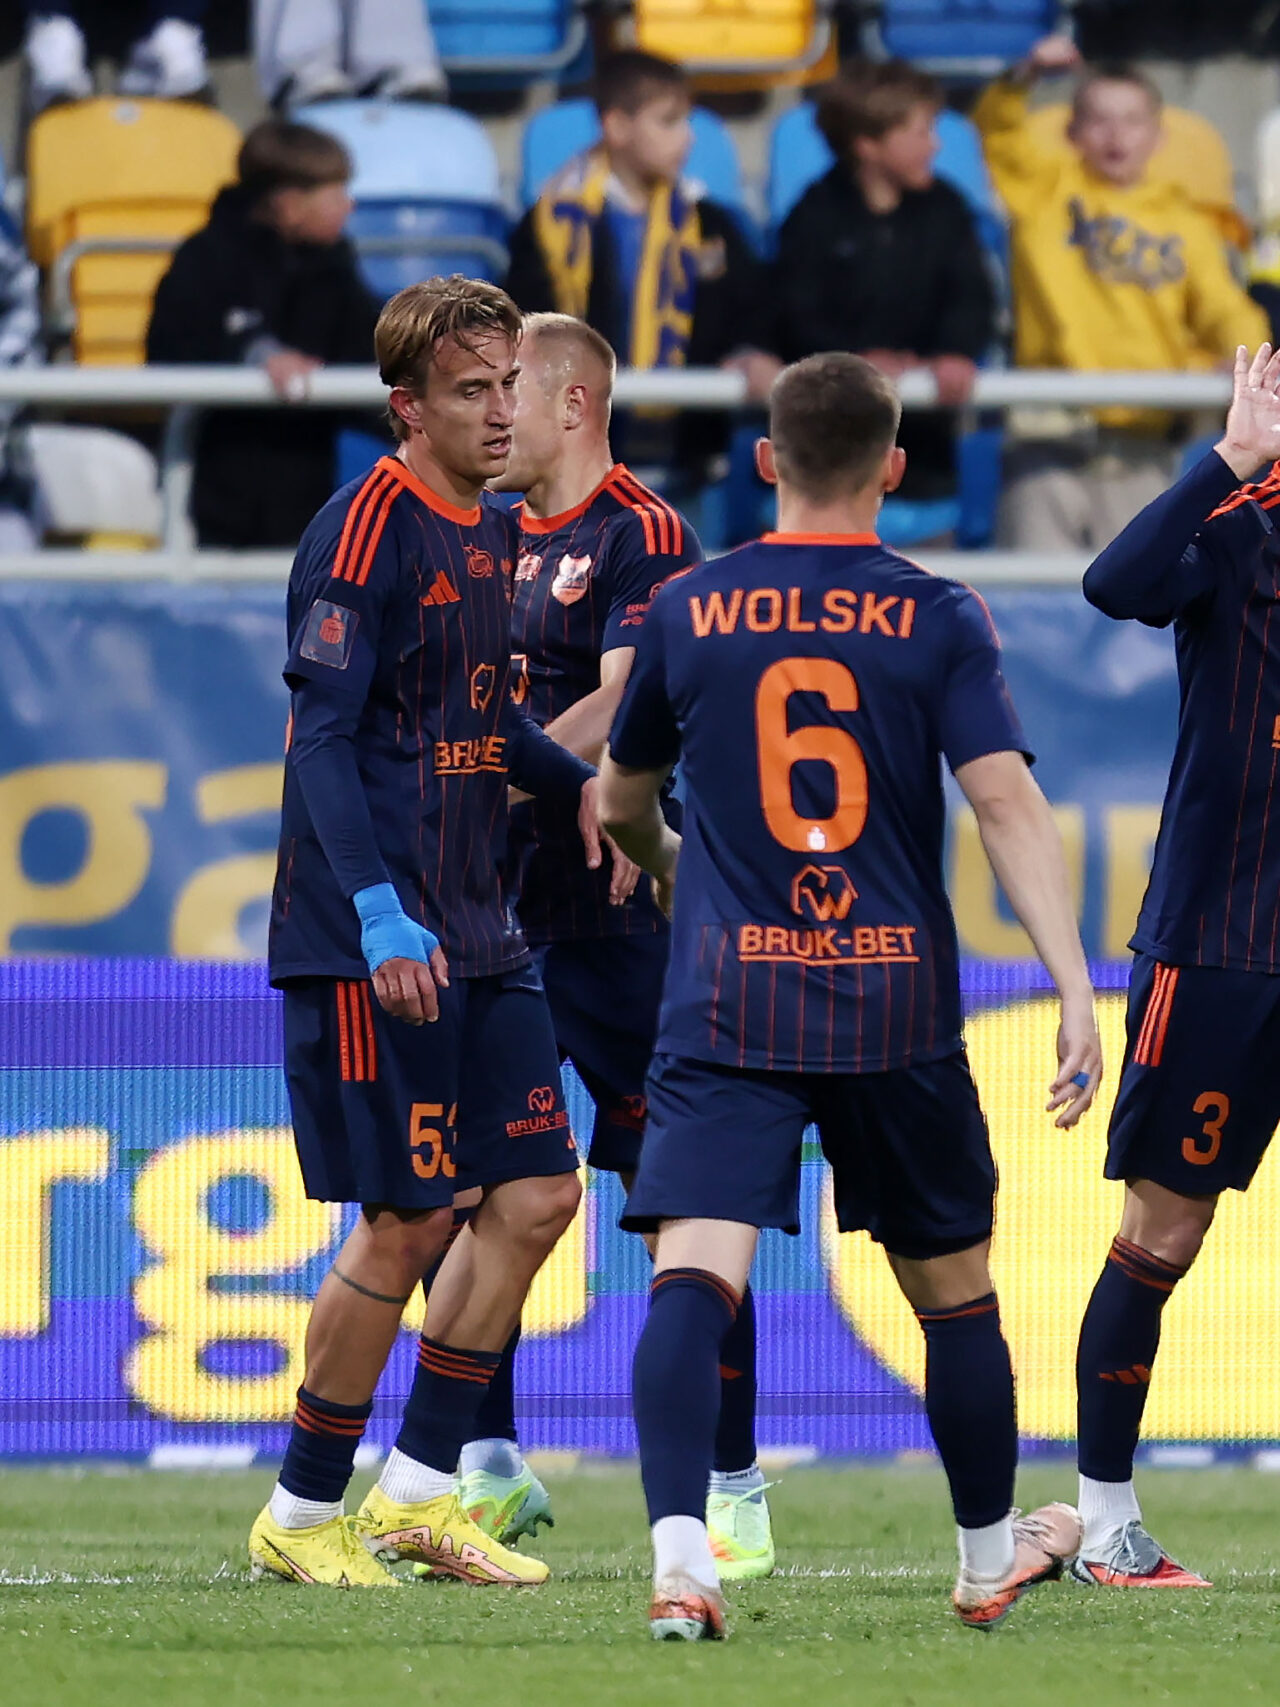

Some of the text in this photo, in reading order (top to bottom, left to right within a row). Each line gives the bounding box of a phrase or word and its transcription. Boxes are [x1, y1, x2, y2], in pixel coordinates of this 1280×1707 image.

[688, 586, 916, 639] WOLSKI
[755, 656, 869, 853] 6
[738, 924, 916, 958] BRUK-BET
[1181, 1091, 1231, 1166] 3
